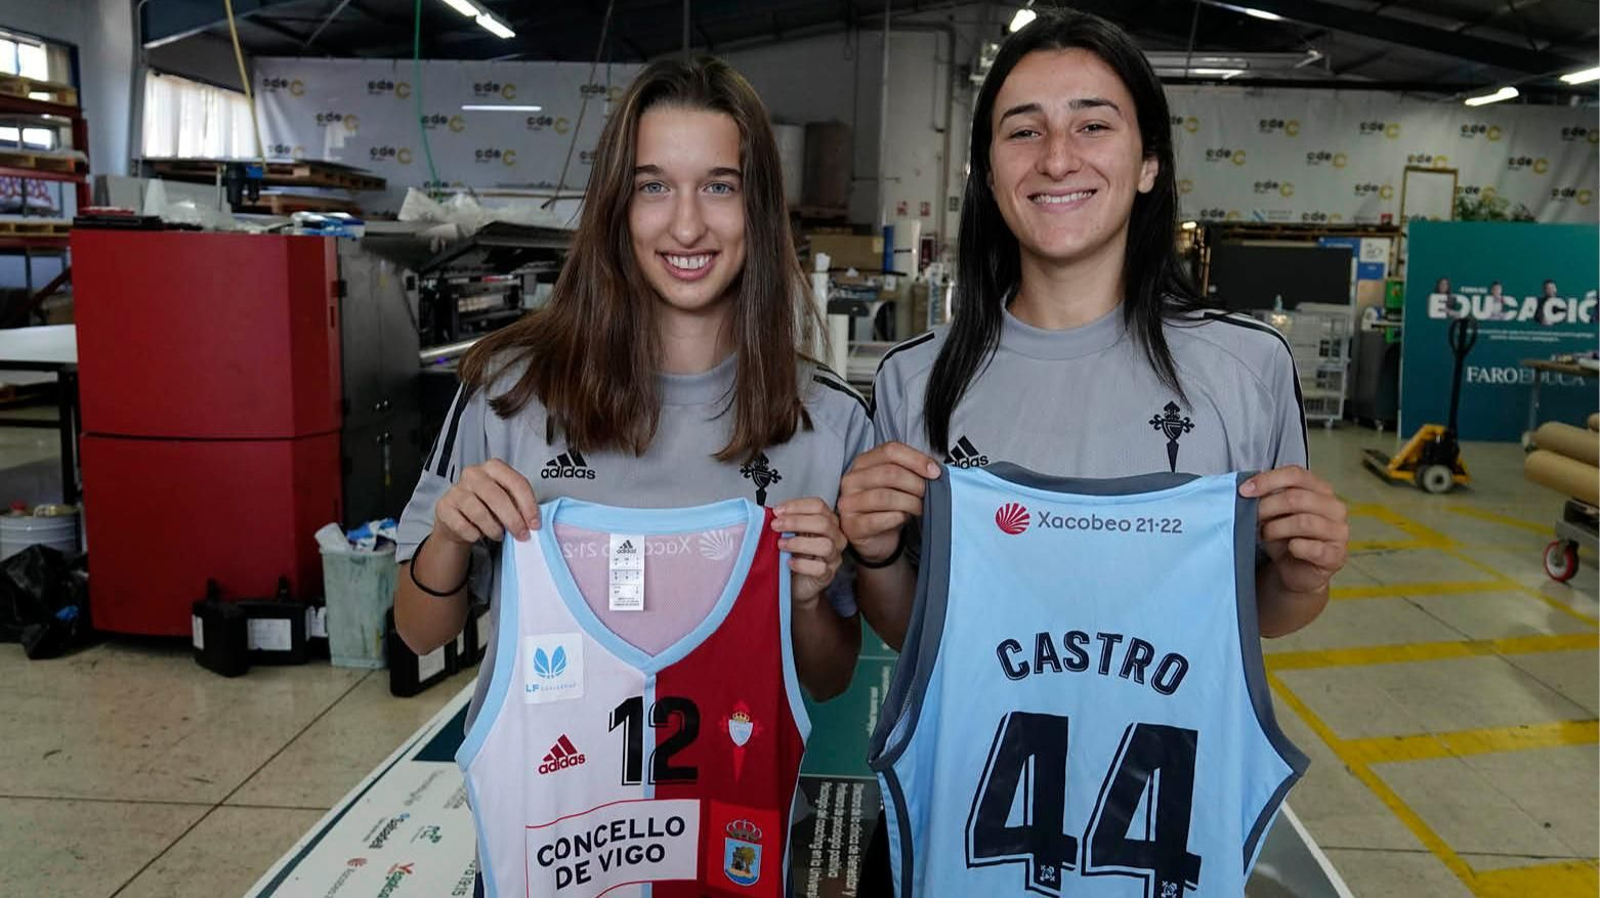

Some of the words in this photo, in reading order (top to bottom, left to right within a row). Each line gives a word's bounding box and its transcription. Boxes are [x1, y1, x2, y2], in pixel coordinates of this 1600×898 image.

[541, 465, 596, 480] adidas
[1037, 511, 1131, 532] Xacobeo
[996, 630, 1189, 695] CASTRO
[526, 684, 539, 693] LF
[608, 695, 700, 786] 12
[538, 753, 585, 775] adidas
[965, 711, 1201, 898] 44
[537, 816, 686, 867] CONCELLO
[556, 859, 592, 890] DE
[598, 844, 665, 872] VIGO
